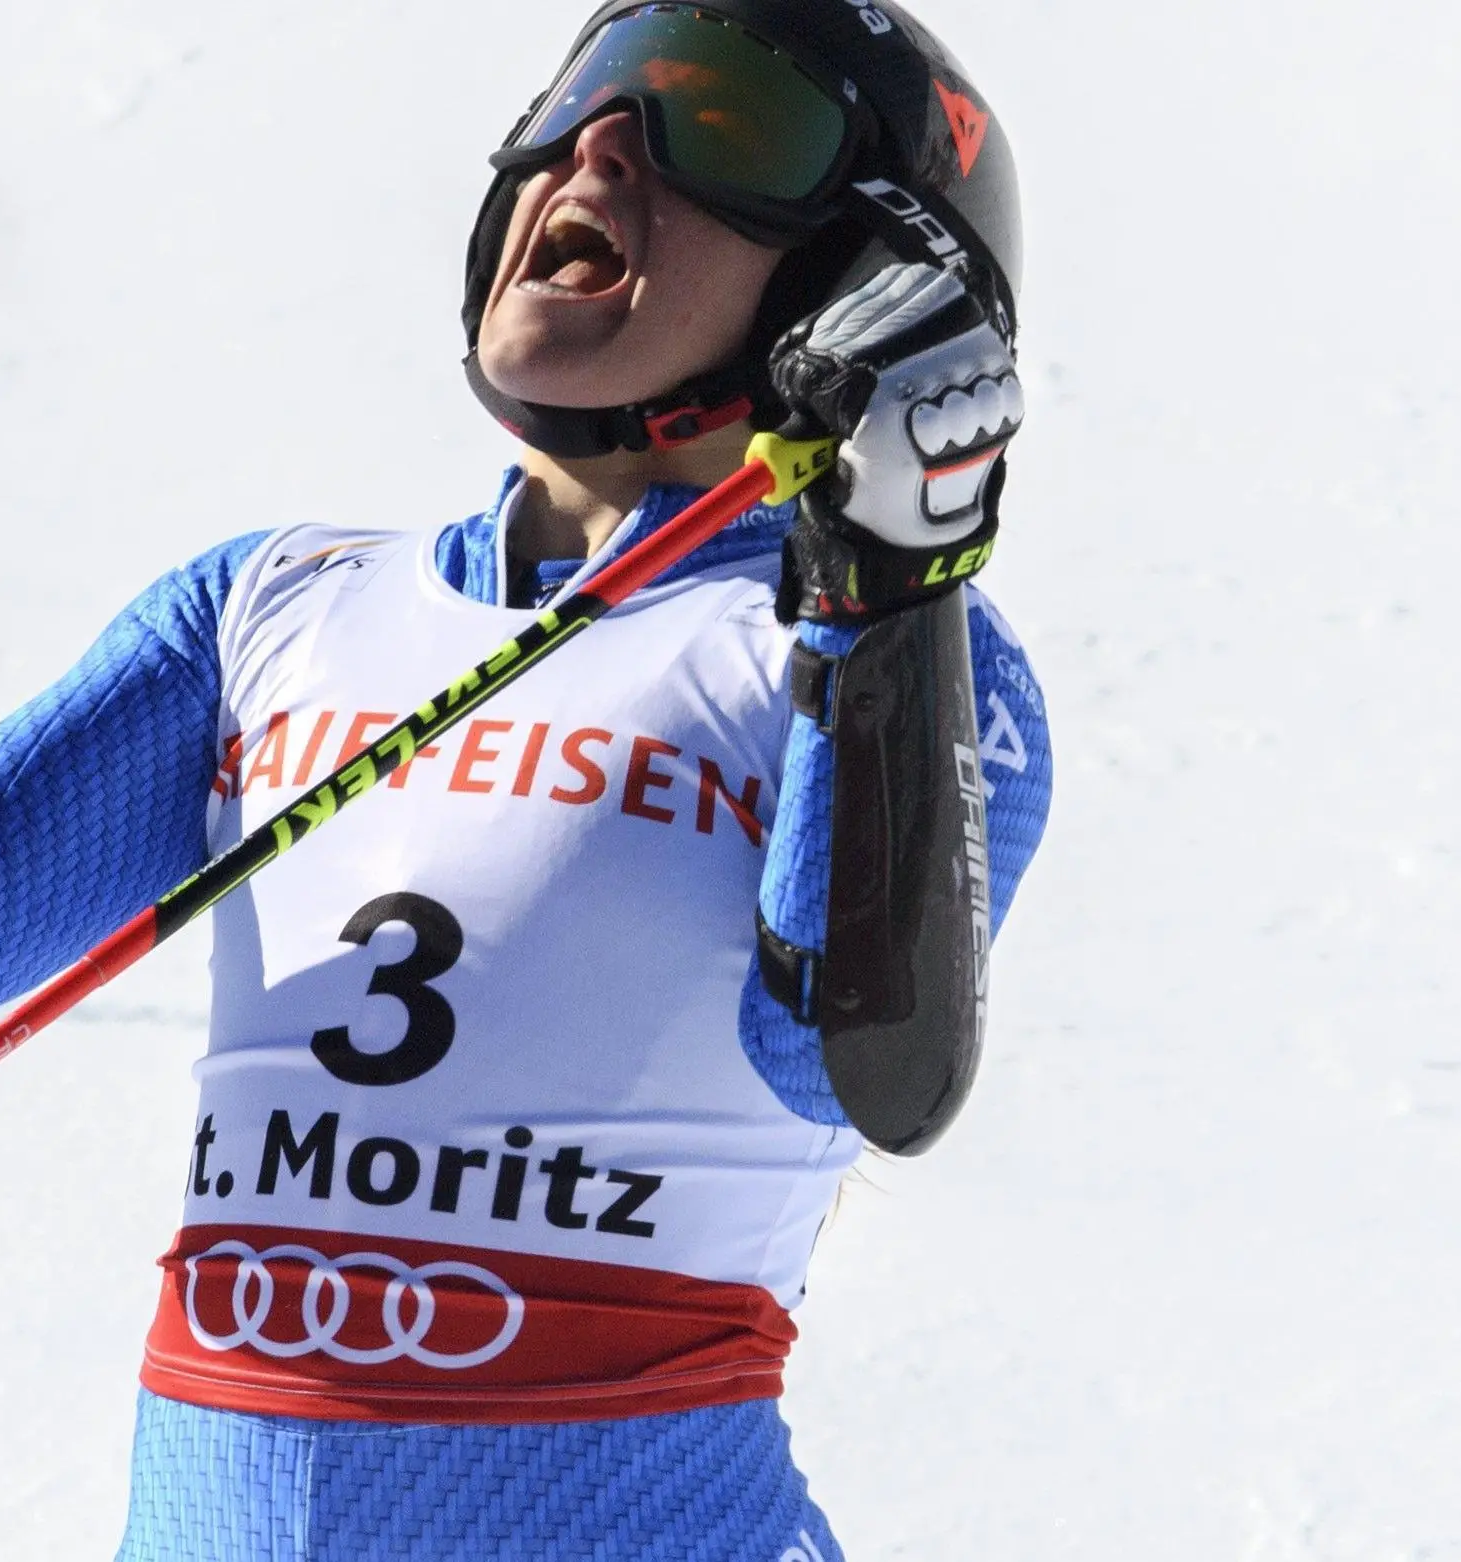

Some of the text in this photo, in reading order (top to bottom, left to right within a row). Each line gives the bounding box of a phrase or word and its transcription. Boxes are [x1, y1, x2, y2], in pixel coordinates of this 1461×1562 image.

[272, 727, 416, 854] LEKI
[310, 891, 464, 1087] 3
[185, 1108, 665, 1239] t. Moritz
